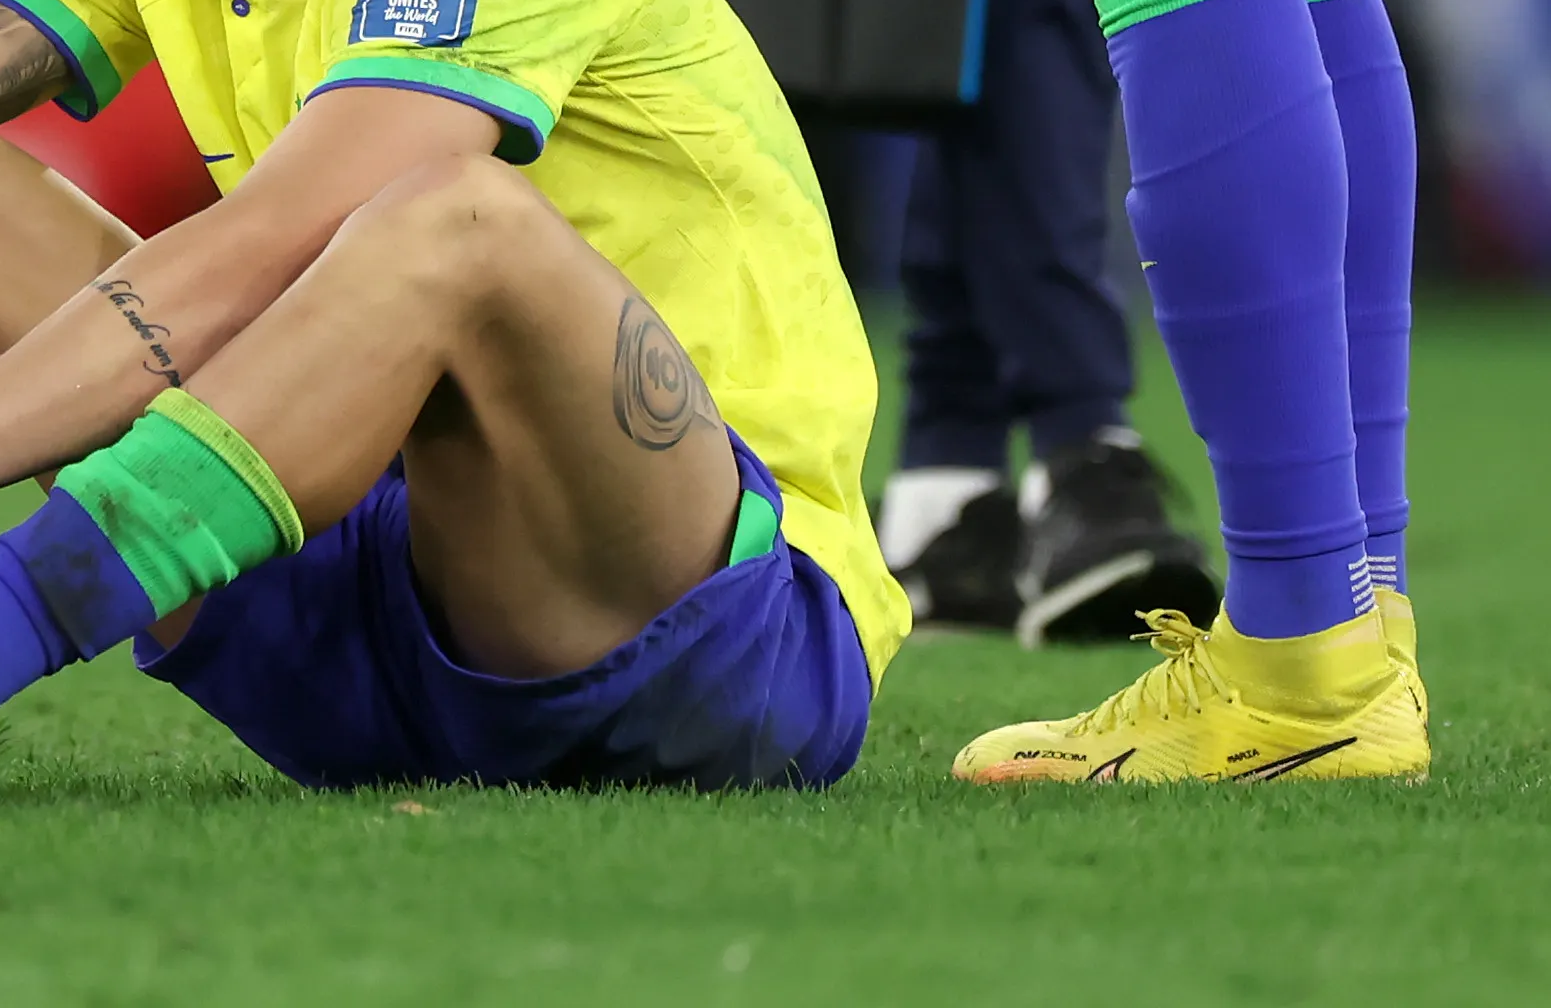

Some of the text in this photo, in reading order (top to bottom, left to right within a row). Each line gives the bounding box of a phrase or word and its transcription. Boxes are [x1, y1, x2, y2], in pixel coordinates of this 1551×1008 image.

[384, 7, 440, 26] the World
[399, 25, 419, 34] FIFA
